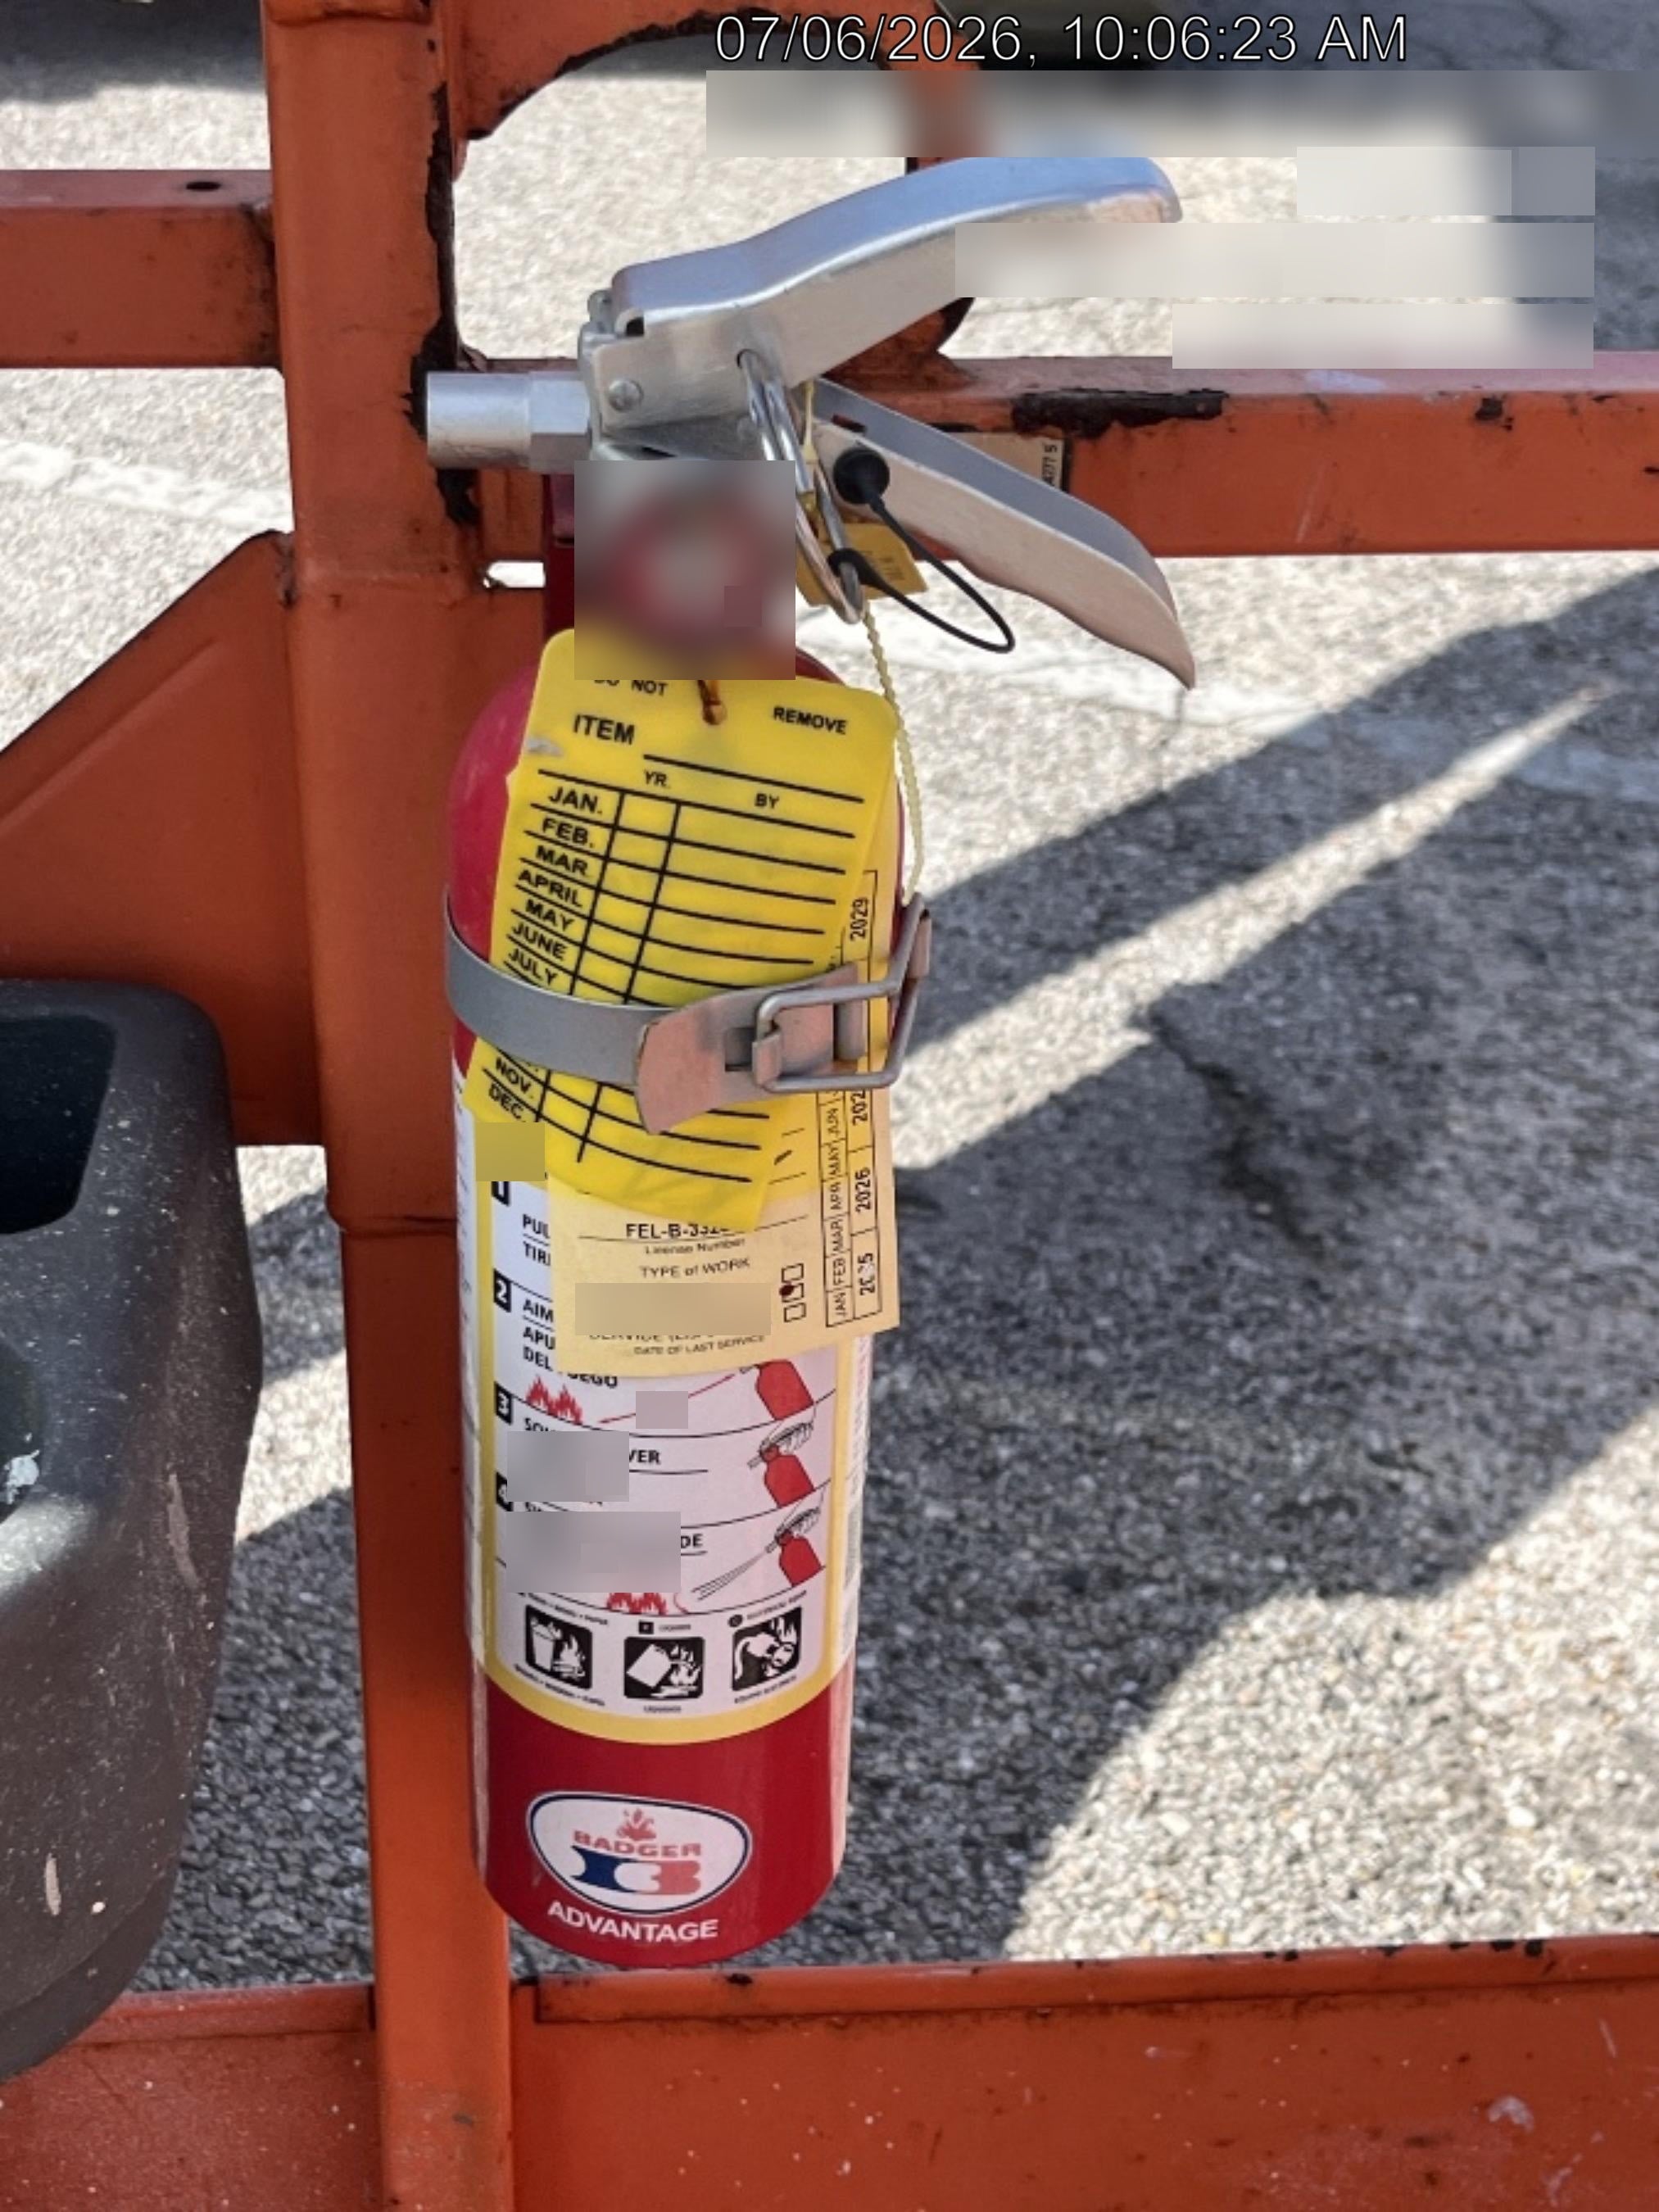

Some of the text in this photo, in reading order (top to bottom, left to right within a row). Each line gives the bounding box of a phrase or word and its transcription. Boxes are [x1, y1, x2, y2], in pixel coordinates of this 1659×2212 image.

[631, 679, 847, 735] NOT REMOVE
[573, 714, 635, 746] ITEM
[548, 786, 602, 815] JAN.
[754, 791, 779, 809] BY
[542, 818, 594, 849] FEB.
[518, 869, 582, 908] APRIL
[525, 899, 573, 931] MAY
[512, 922, 568, 961] JUNE
[508, 949, 559, 986] JULY
[850, 897, 876, 1296] 205 2026 202 2029
[827, 1145, 840, 1176] MAY
[830, 1181, 842, 1211] APR
[522, 1213, 551, 1240] PUL
[830, 1217, 844, 1252] MAR
[697, 1238, 746, 1253] Number
[640, 1257, 751, 1279] TYPE of WORK
[832, 1258, 846, 1286] FEB
[522, 1298, 555, 1323] AIM
[834, 1291, 846, 1317] JAN
[522, 1326, 556, 1350] APU
[632, 1345, 664, 1355] DATE
[667, 1345, 682, 1355] OF
[685, 1342, 714, 1353] LAST
[717, 1335, 764, 1350] SERVICE
[522, 1344, 554, 1372] DEL
[573, 1830, 702, 1858] BADGER
[546, 1900, 719, 1942] ADVANTAGE
